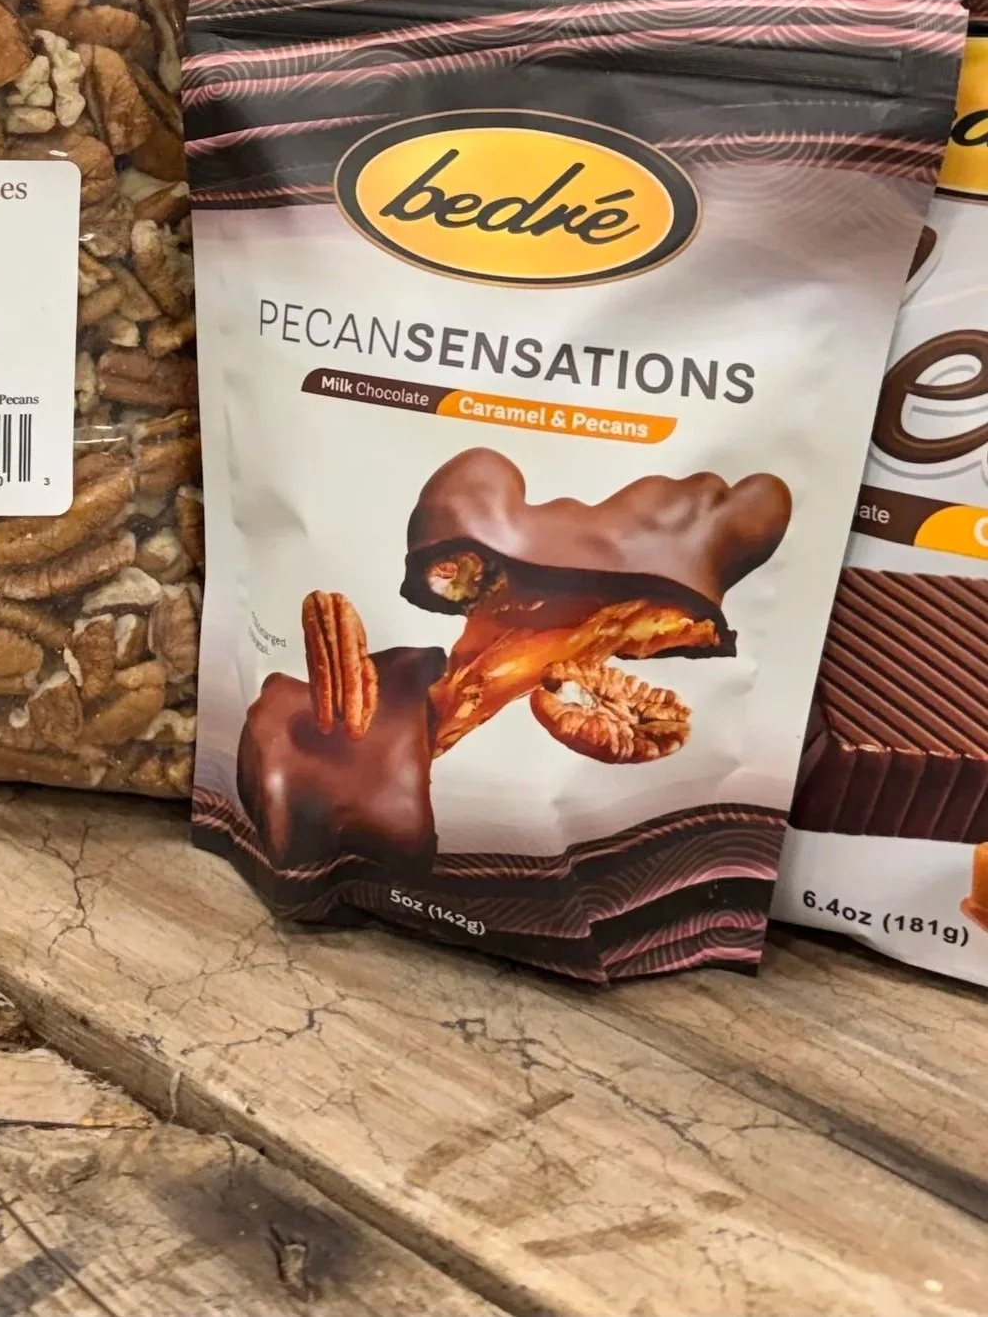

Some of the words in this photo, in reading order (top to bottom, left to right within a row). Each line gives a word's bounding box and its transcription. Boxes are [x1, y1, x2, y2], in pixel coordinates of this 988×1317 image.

[380, 149, 639, 246] bedré
[321, 375, 353, 393] Milk
[356, 381, 429, 406] Chocolate
[459, 396, 545, 425] Caramel
[550, 410, 566, 427] &
[572, 412, 648, 437] Pecans
[390, 889, 423, 912] 5oz
[428, 904, 485, 935] (142g)
[803, 890, 872, 926] 6.4oz
[882, 913, 969, 947] (181g)
